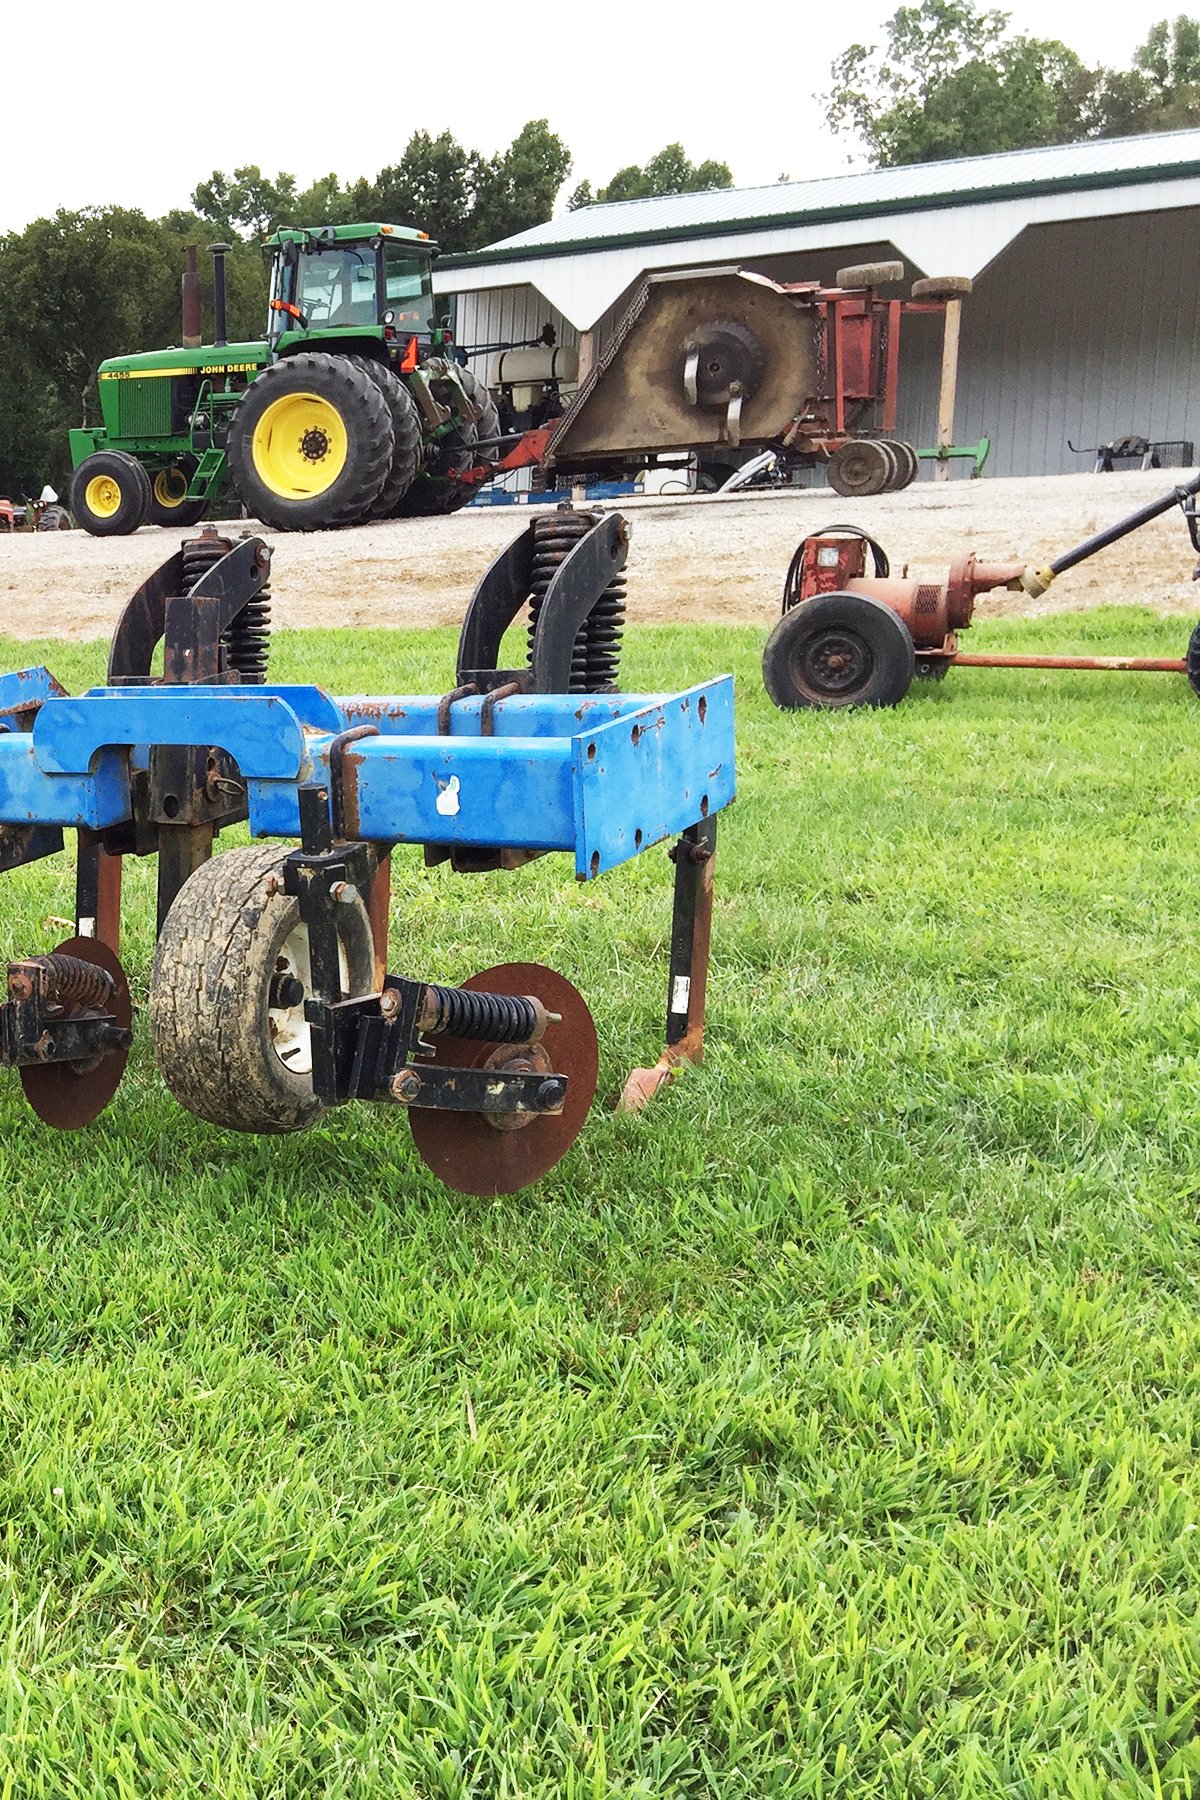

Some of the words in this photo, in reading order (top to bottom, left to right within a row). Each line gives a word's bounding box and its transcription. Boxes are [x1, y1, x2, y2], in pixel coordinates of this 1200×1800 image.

[200, 365, 225, 374] JOHN
[226, 363, 258, 373] DEERE
[107, 371, 131, 379] 4455
